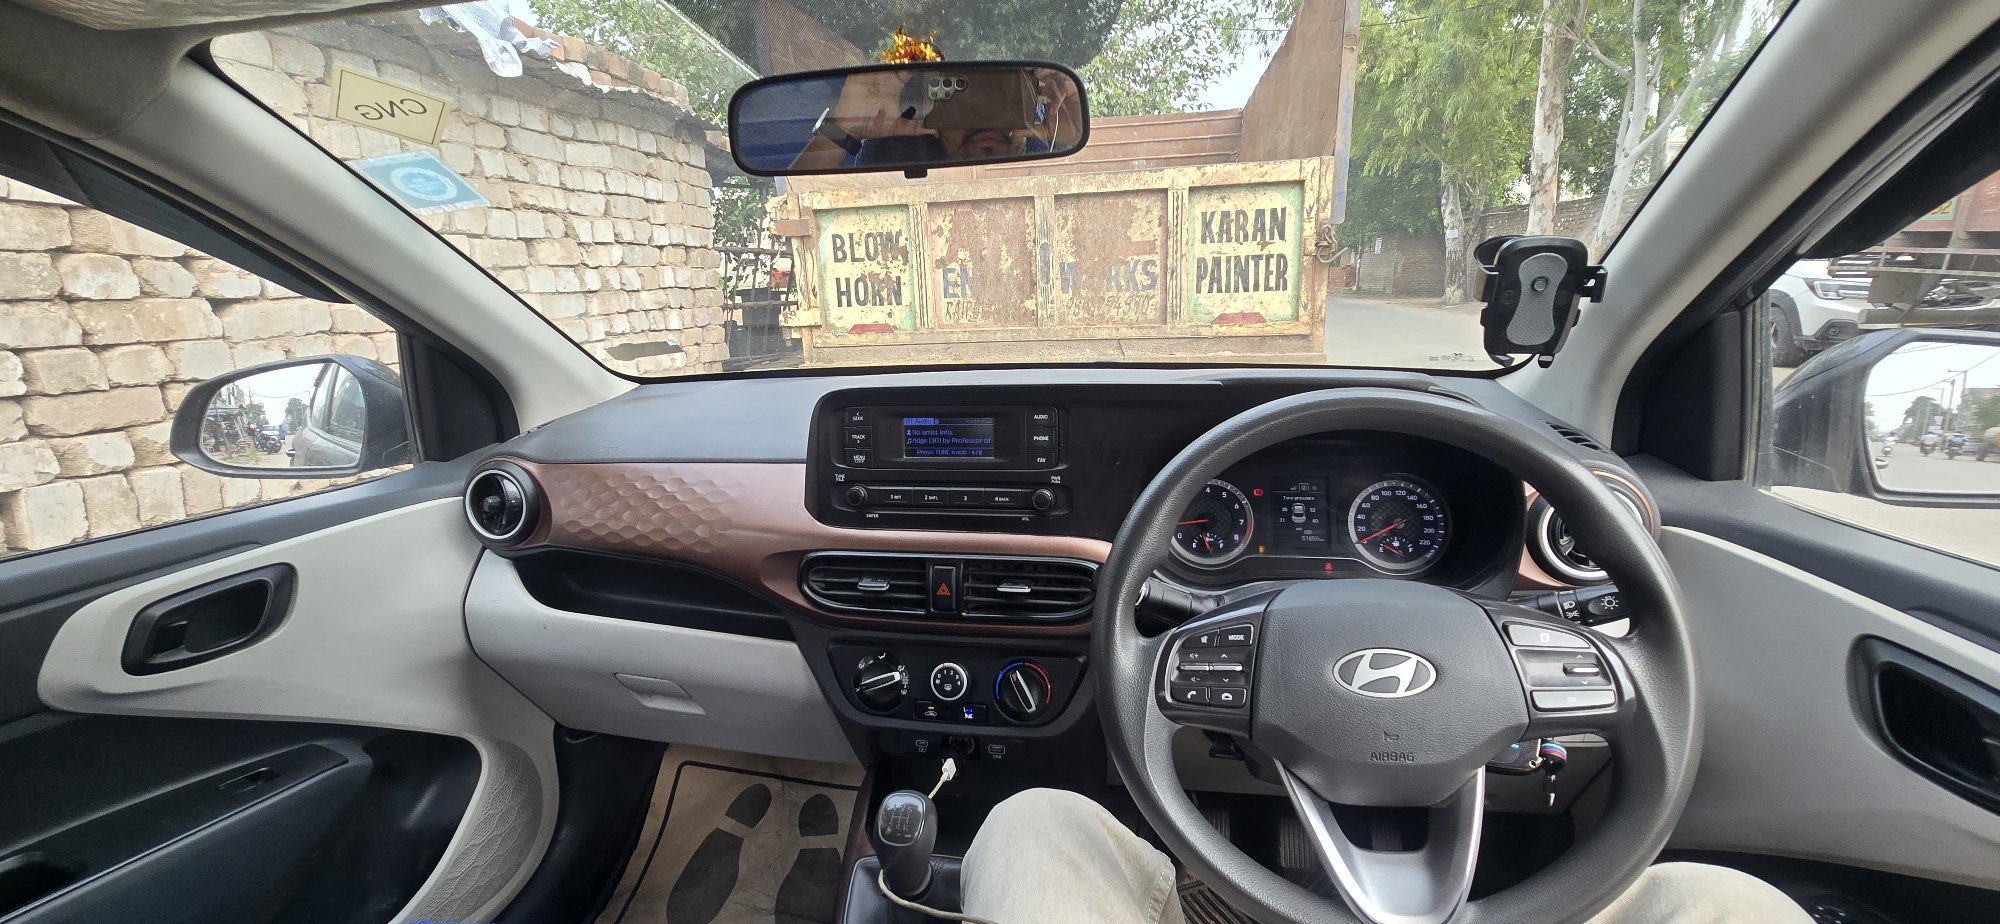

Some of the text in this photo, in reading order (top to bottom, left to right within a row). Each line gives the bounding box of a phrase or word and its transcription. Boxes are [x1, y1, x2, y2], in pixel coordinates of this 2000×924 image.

[1200, 207, 1287, 244] KARAN
[832, 230, 903, 264] BLOW
[1195, 253, 1288, 294] PAINTER
[836, 275, 903, 308] HORN
[1370, 751, 1415, 762] AIRBAG
